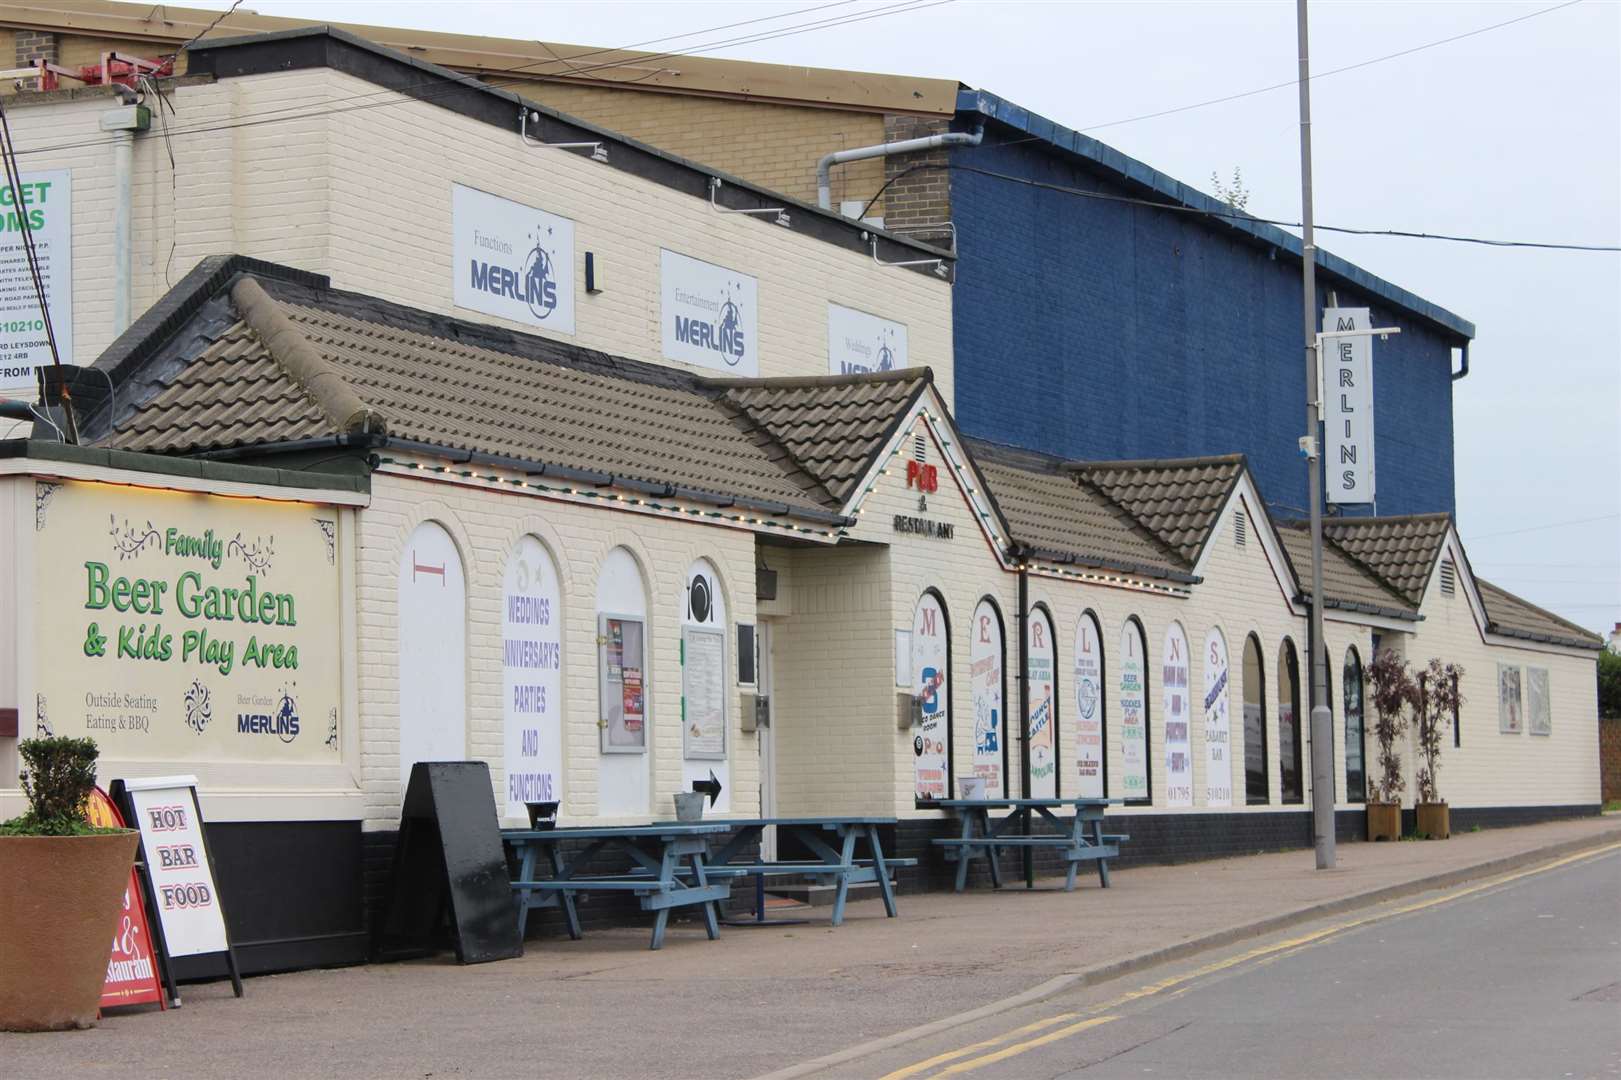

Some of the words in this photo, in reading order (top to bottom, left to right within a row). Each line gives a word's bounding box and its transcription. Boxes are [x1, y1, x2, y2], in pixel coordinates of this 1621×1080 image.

[473, 229, 513, 255] Functions
[471, 259, 557, 310] MERLINS
[675, 315, 744, 357] MERLINS
[1336, 317, 1357, 490] MERLINS
[907, 459, 938, 494] PUB
[165, 527, 224, 569] Family
[84, 560, 168, 615] Beer
[175, 570, 297, 626] Garden
[508, 595, 551, 626] WEDDINGS
[83, 622, 107, 657] &
[117, 623, 173, 662] Kids
[182, 627, 234, 676] Play
[241, 635, 299, 670] Area
[502, 639, 560, 671] NNIVERSARY'S
[85, 692, 121, 708] Outside
[124, 693, 157, 713] Seating
[513, 685, 546, 714] PARTIES
[86, 713, 117, 733] Eating
[119, 715, 126, 730] &
[128, 715, 149, 733] BBQ
[237, 714, 300, 735] MERLINS
[521, 729, 539, 757] AND
[509, 772, 553, 803] FUNCTIONS
[1167, 786, 1190, 801] 01795
[149, 808, 187, 831] HOT
[158, 847, 197, 869] BAR
[162, 884, 212, 908] FOOD
